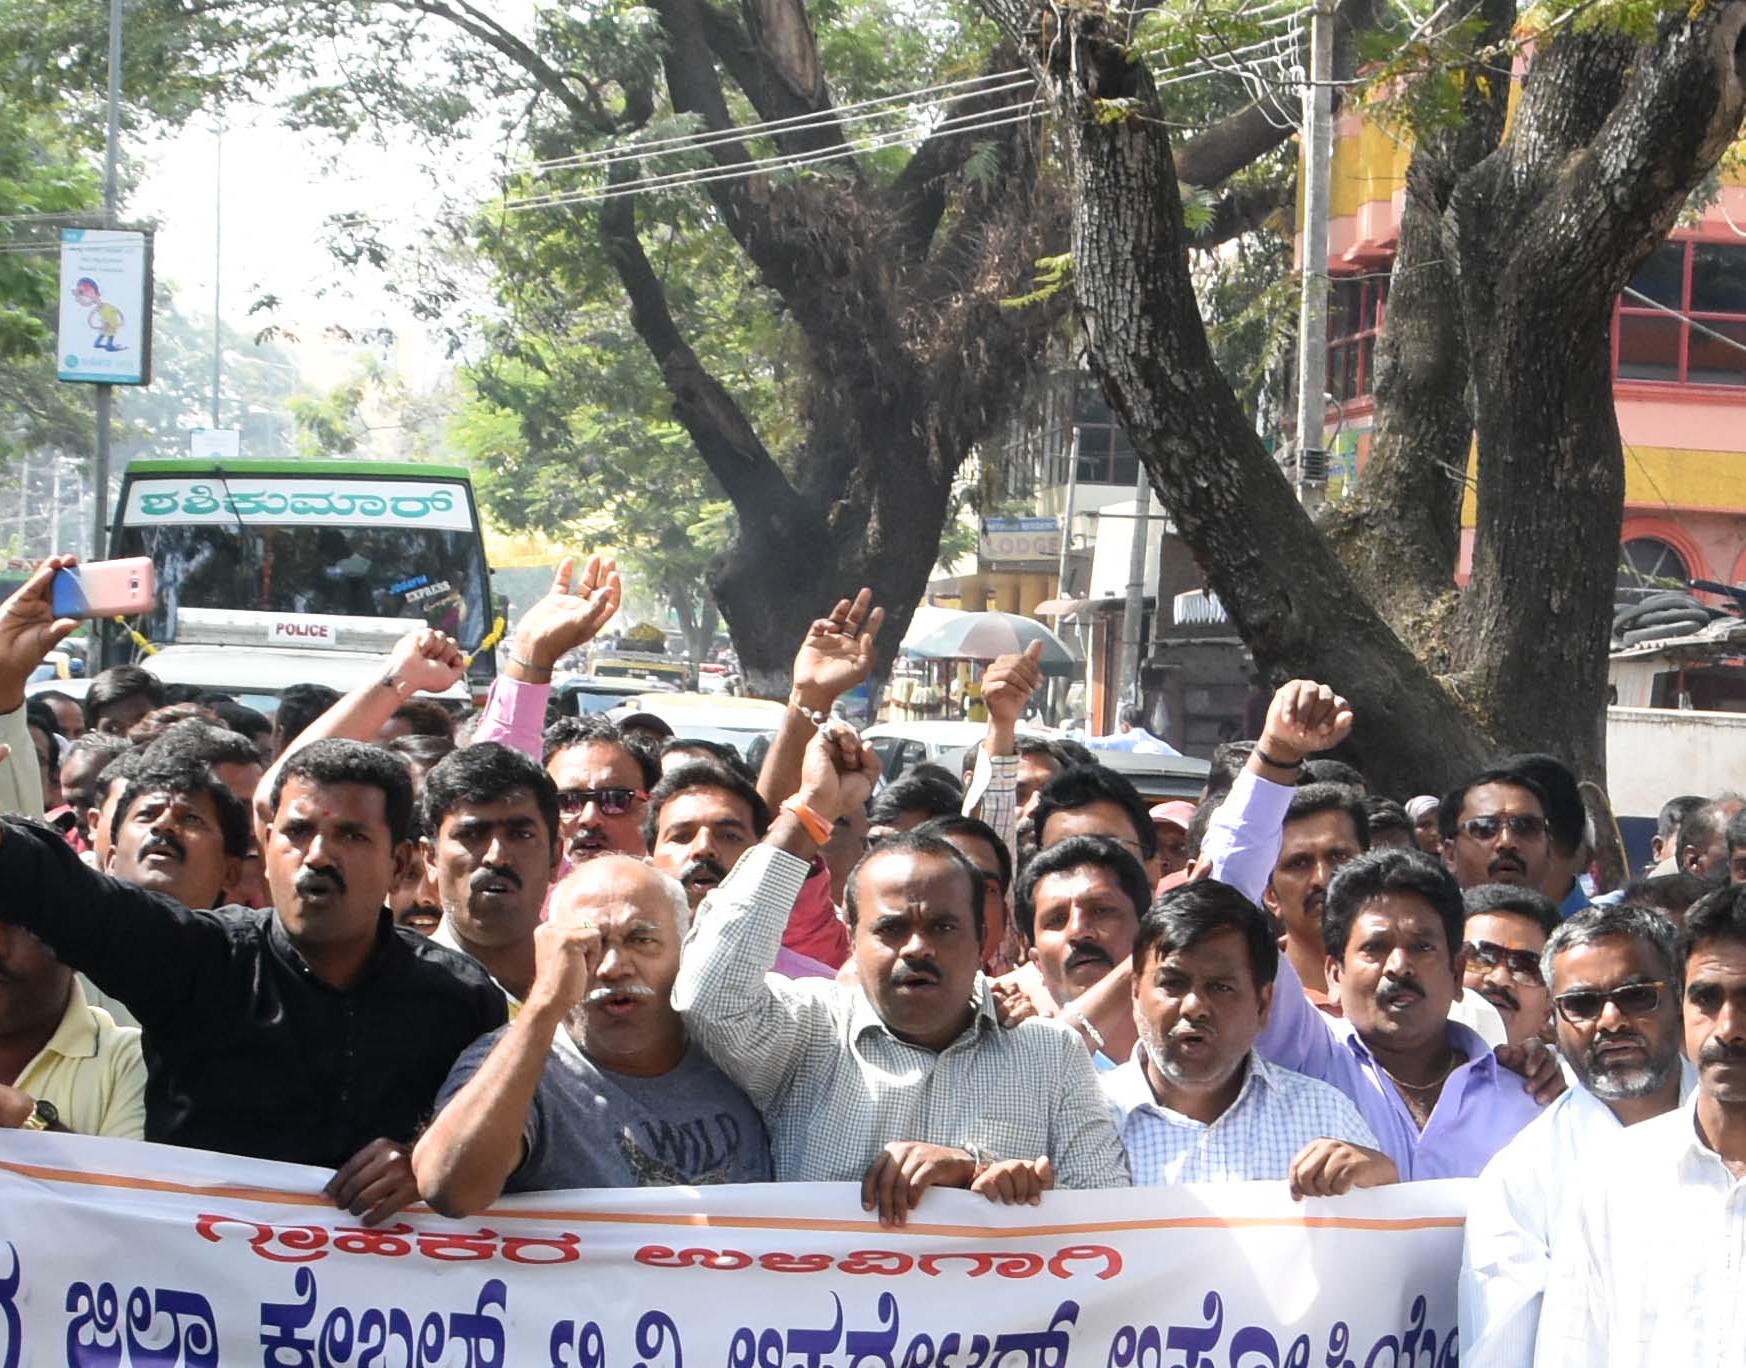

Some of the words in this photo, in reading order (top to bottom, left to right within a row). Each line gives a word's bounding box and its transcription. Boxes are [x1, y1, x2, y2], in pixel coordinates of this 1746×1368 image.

[139, 485, 454, 519] ಶಶಿಕುಮಾರ್
[405, 580, 451, 603] EXPRESS
[275, 622, 329, 639] POLICE
[638, 1111, 741, 1175] WILD
[196, 1213, 580, 1264] ಗ್ರಾಹಕರ
